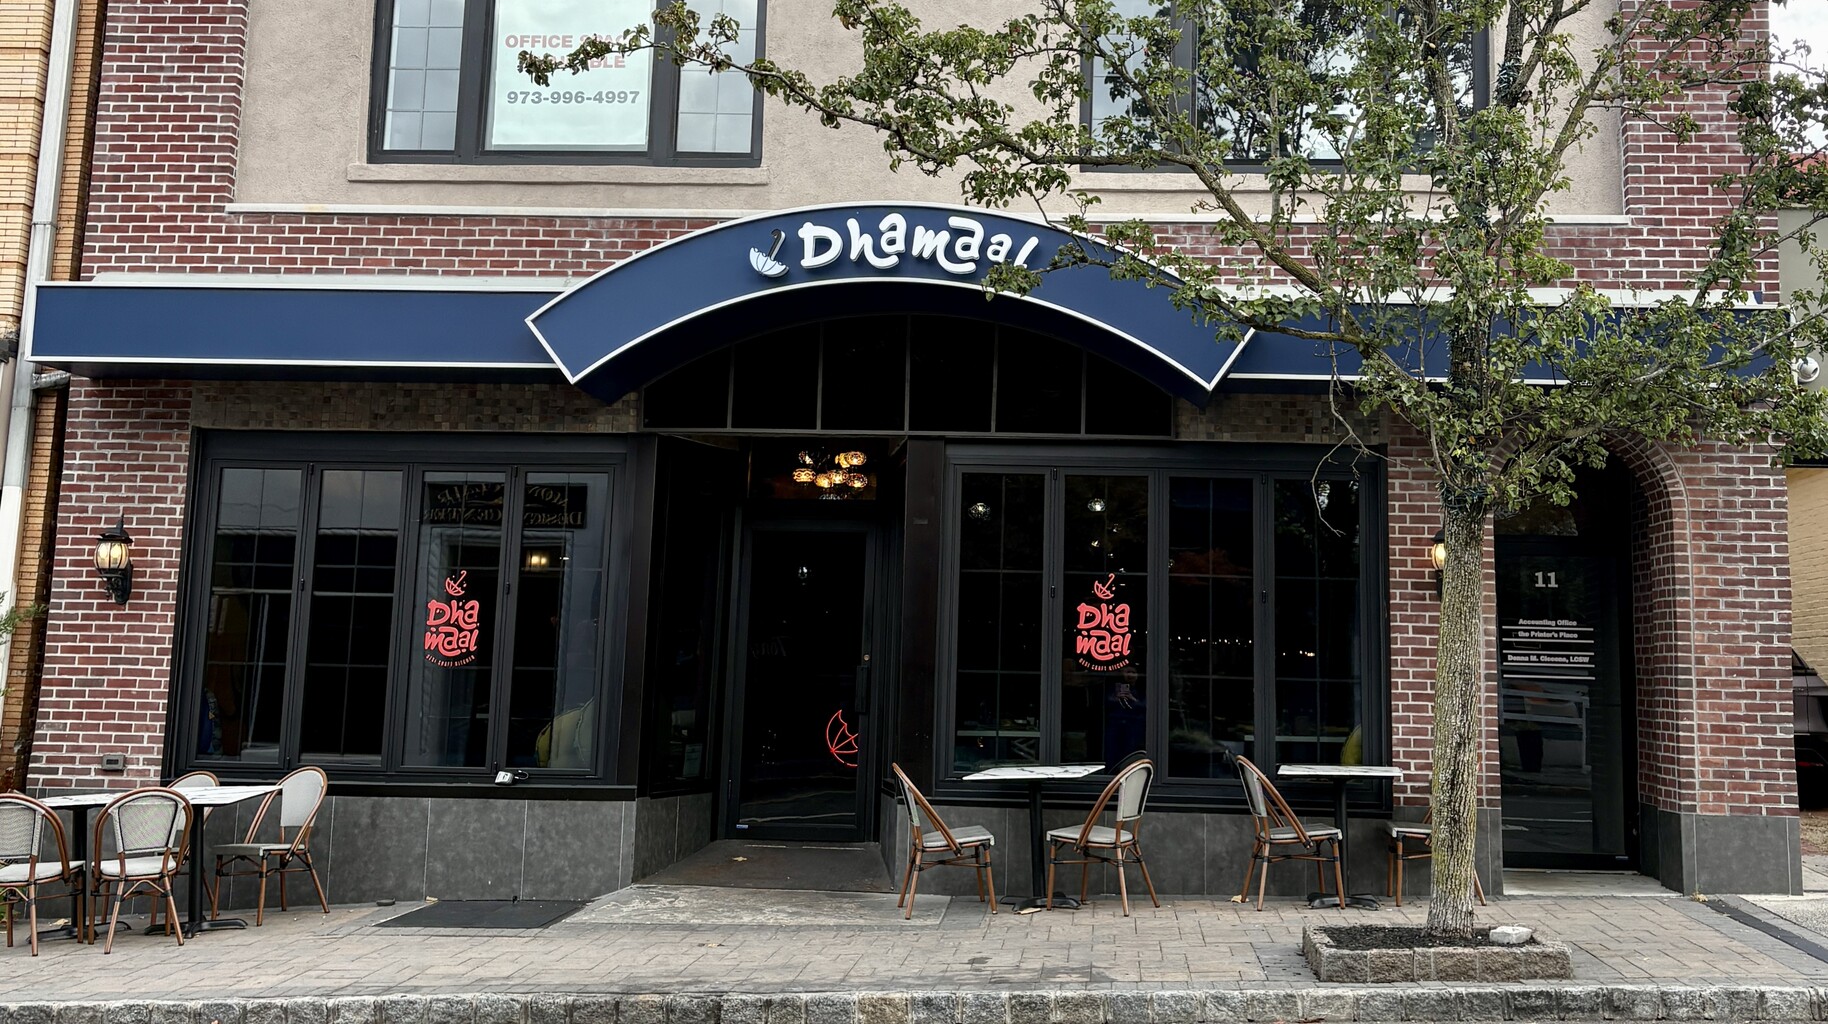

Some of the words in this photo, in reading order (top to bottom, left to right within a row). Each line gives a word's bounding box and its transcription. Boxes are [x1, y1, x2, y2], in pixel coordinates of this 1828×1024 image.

[505, 34, 573, 48] OFFICE
[507, 91, 640, 104] 973-996-4997
[797, 212, 1039, 274] Dhamaal
[1535, 571, 1558, 588] 11
[427, 599, 479, 630] Dha
[1076, 602, 1130, 633] Dha
[1518, 618, 1556, 627] Accounting
[1557, 619, 1577, 627] Office
[424, 626, 479, 657] maal
[1076, 629, 1131, 660] maal
